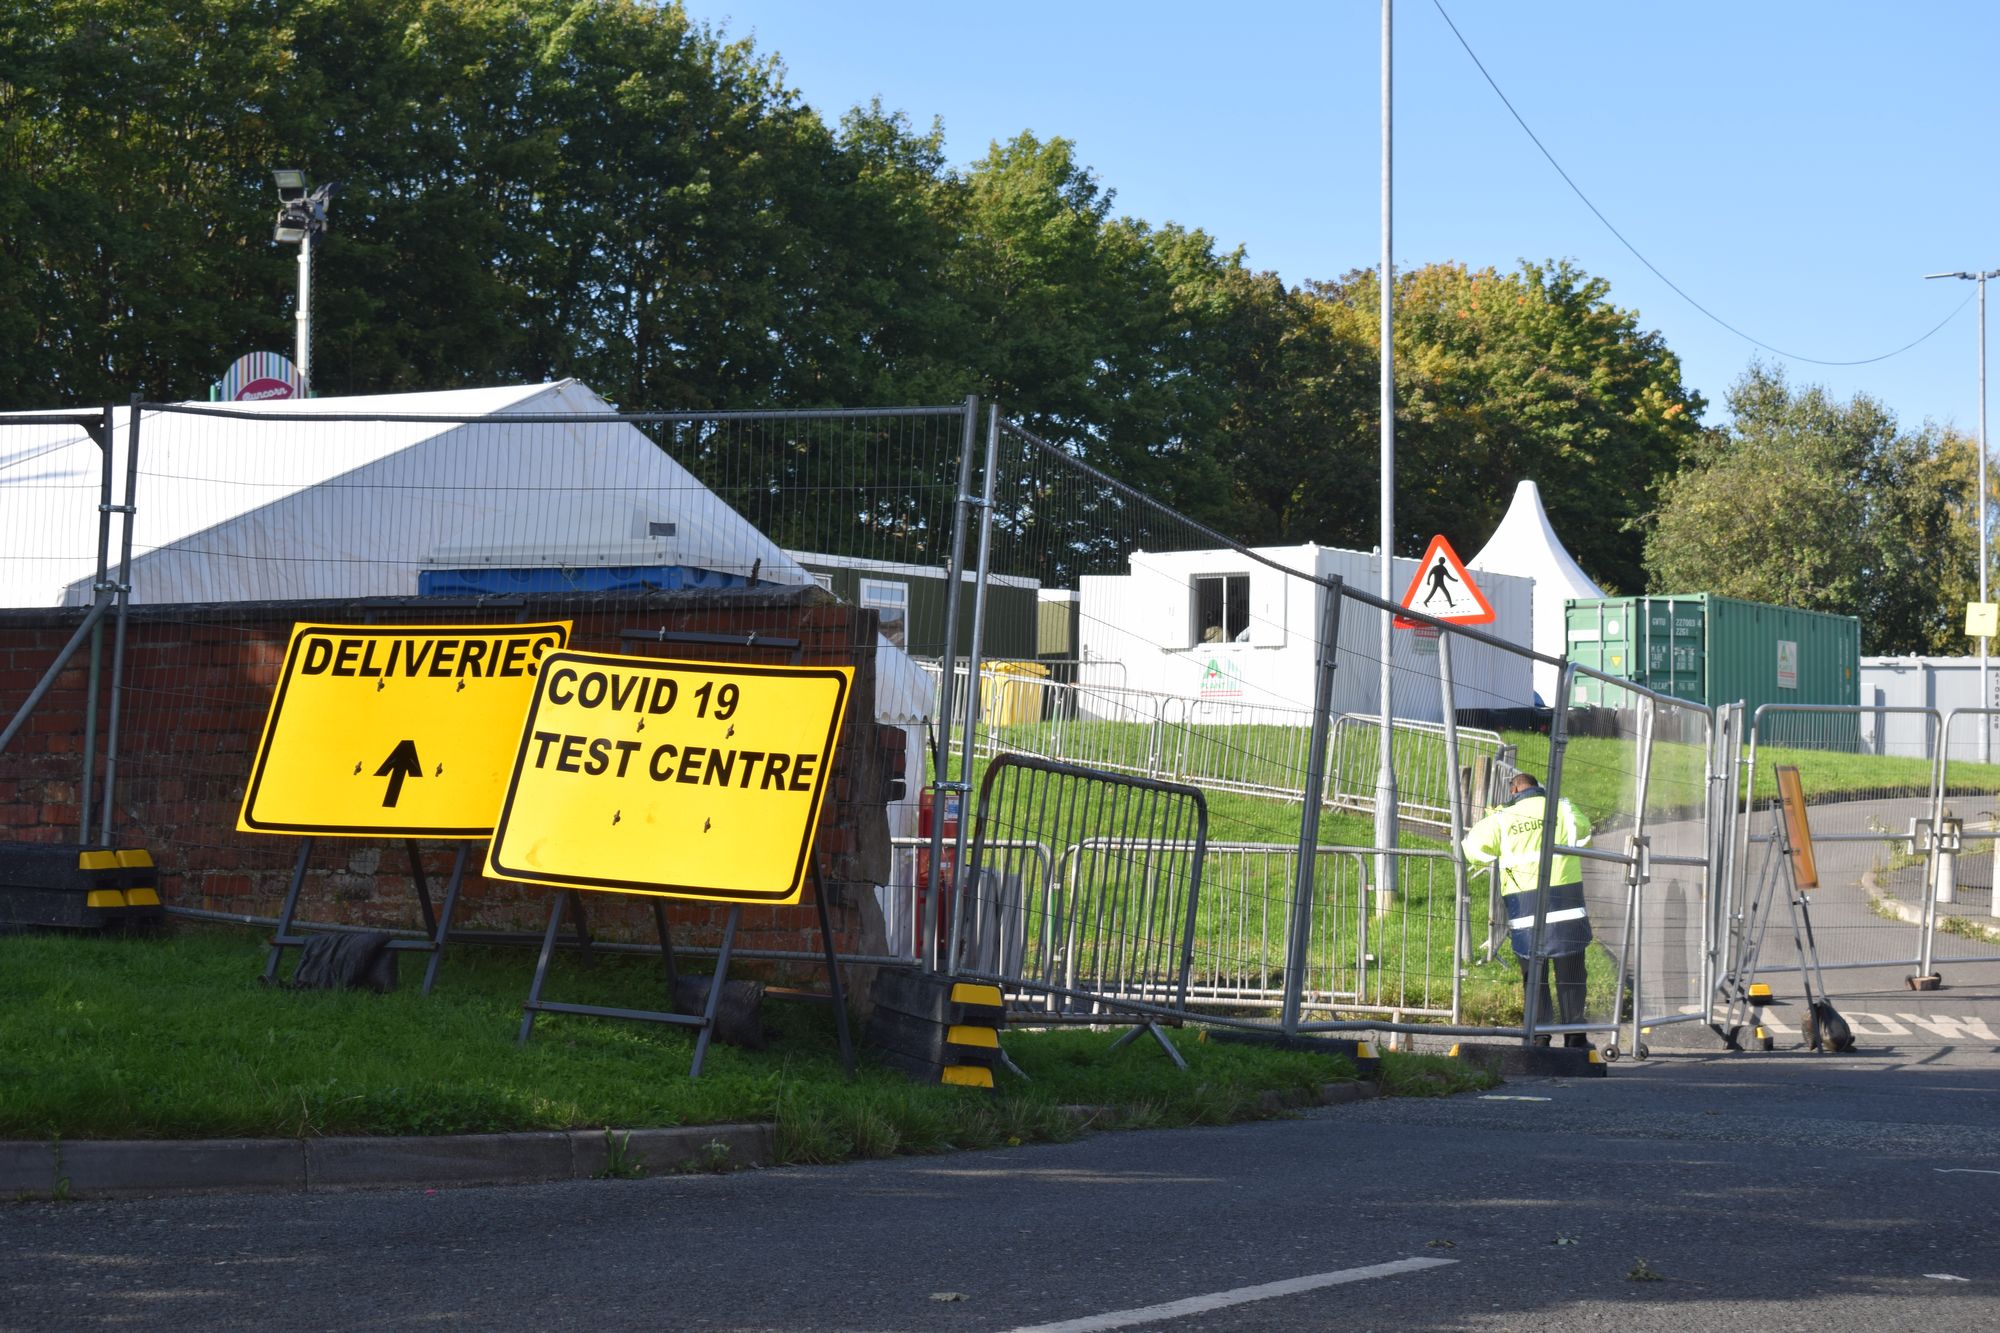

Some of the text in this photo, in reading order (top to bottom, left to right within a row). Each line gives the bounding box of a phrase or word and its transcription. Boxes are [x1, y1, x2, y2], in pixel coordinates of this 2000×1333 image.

[302, 638, 554, 677] DELIVERIES
[549, 669, 740, 721] COVID 19
[535, 732, 818, 792] TEST CENTRE
